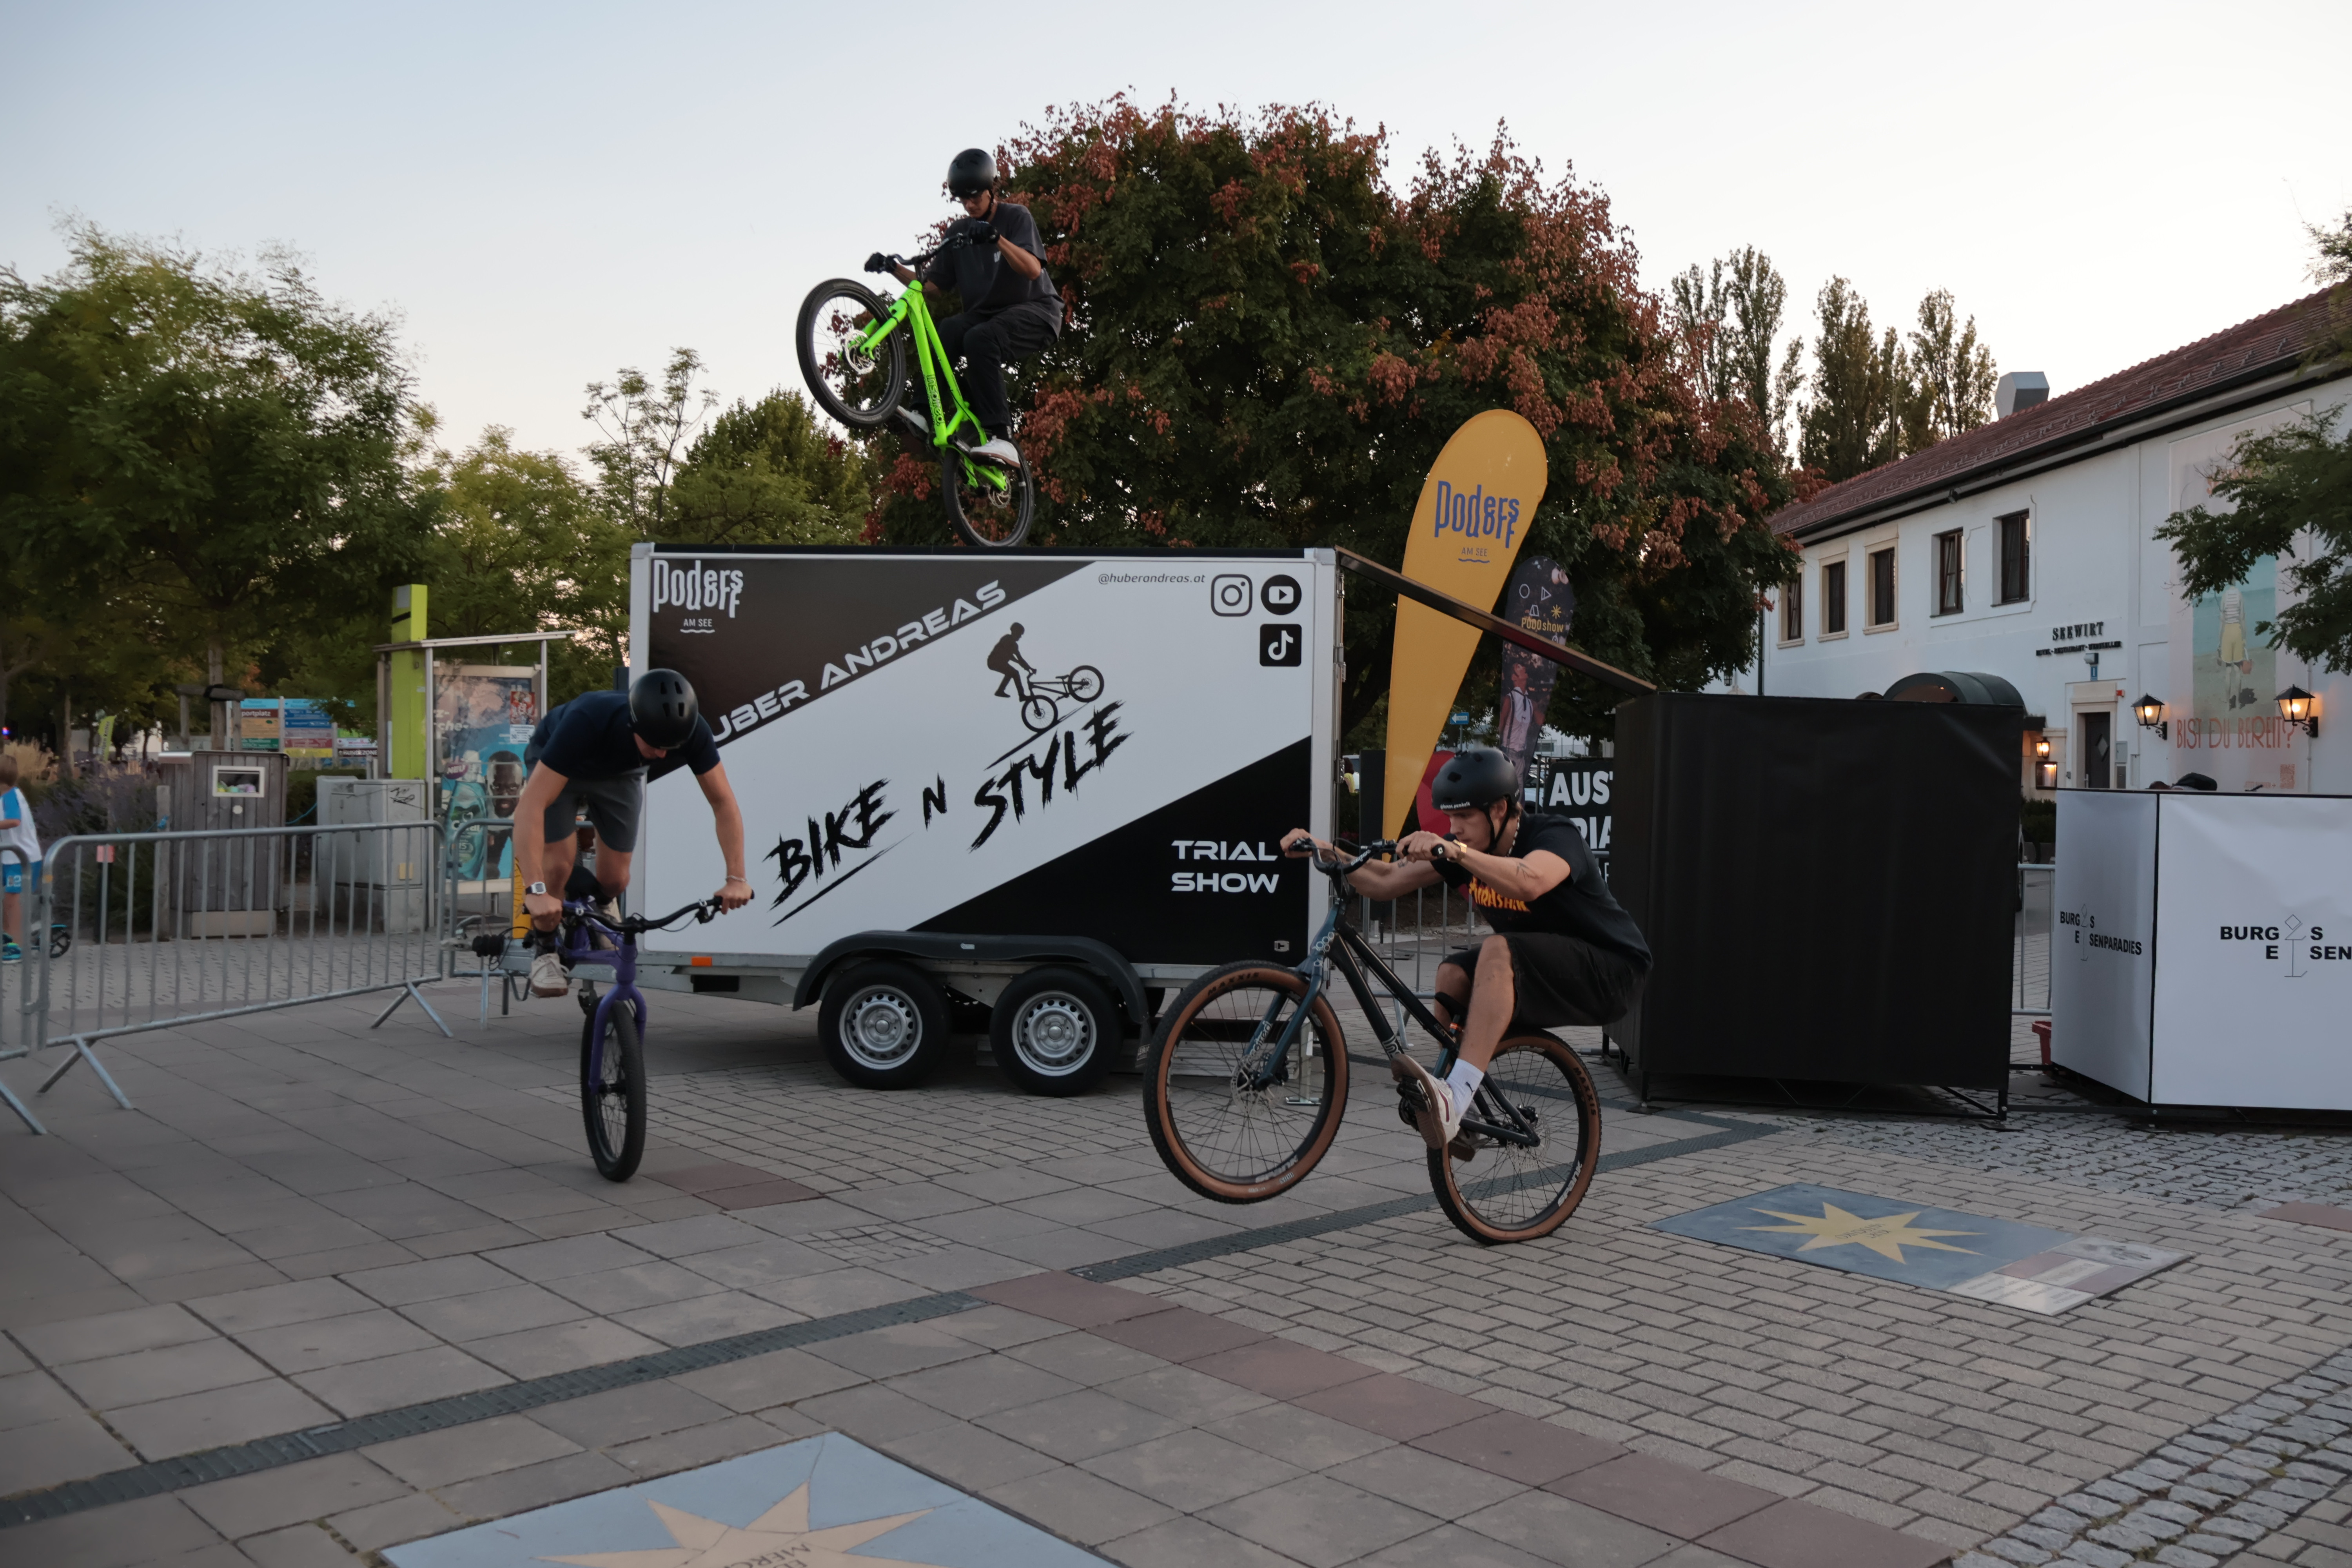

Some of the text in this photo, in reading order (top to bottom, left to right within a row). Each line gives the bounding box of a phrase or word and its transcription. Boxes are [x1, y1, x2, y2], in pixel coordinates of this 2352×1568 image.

[1461, 547, 1488, 557] AM SEE
[1098, 573, 1205, 585] @huberandreas.at
[683, 619, 713, 627] AM SEE
[2052, 621, 2104, 641] SEEWIRT
[712, 580, 1006, 742] UBER ANDREAS
[2176, 718, 2202, 749] BIST
[2209, 717, 2230, 748] DU
[447, 765, 466, 775] NEU
[762, 699, 1135, 913] BIKE N STYLE
[1171, 840, 1278, 861] TRIAL
[1171, 872, 1279, 894] SHOW
[2060, 911, 2080, 926] BURG
[2220, 926, 2279, 941] BURG
[2089, 933, 2142, 956] SENPARADIES
[1573, 1067, 1596, 1116] MAXXIS
